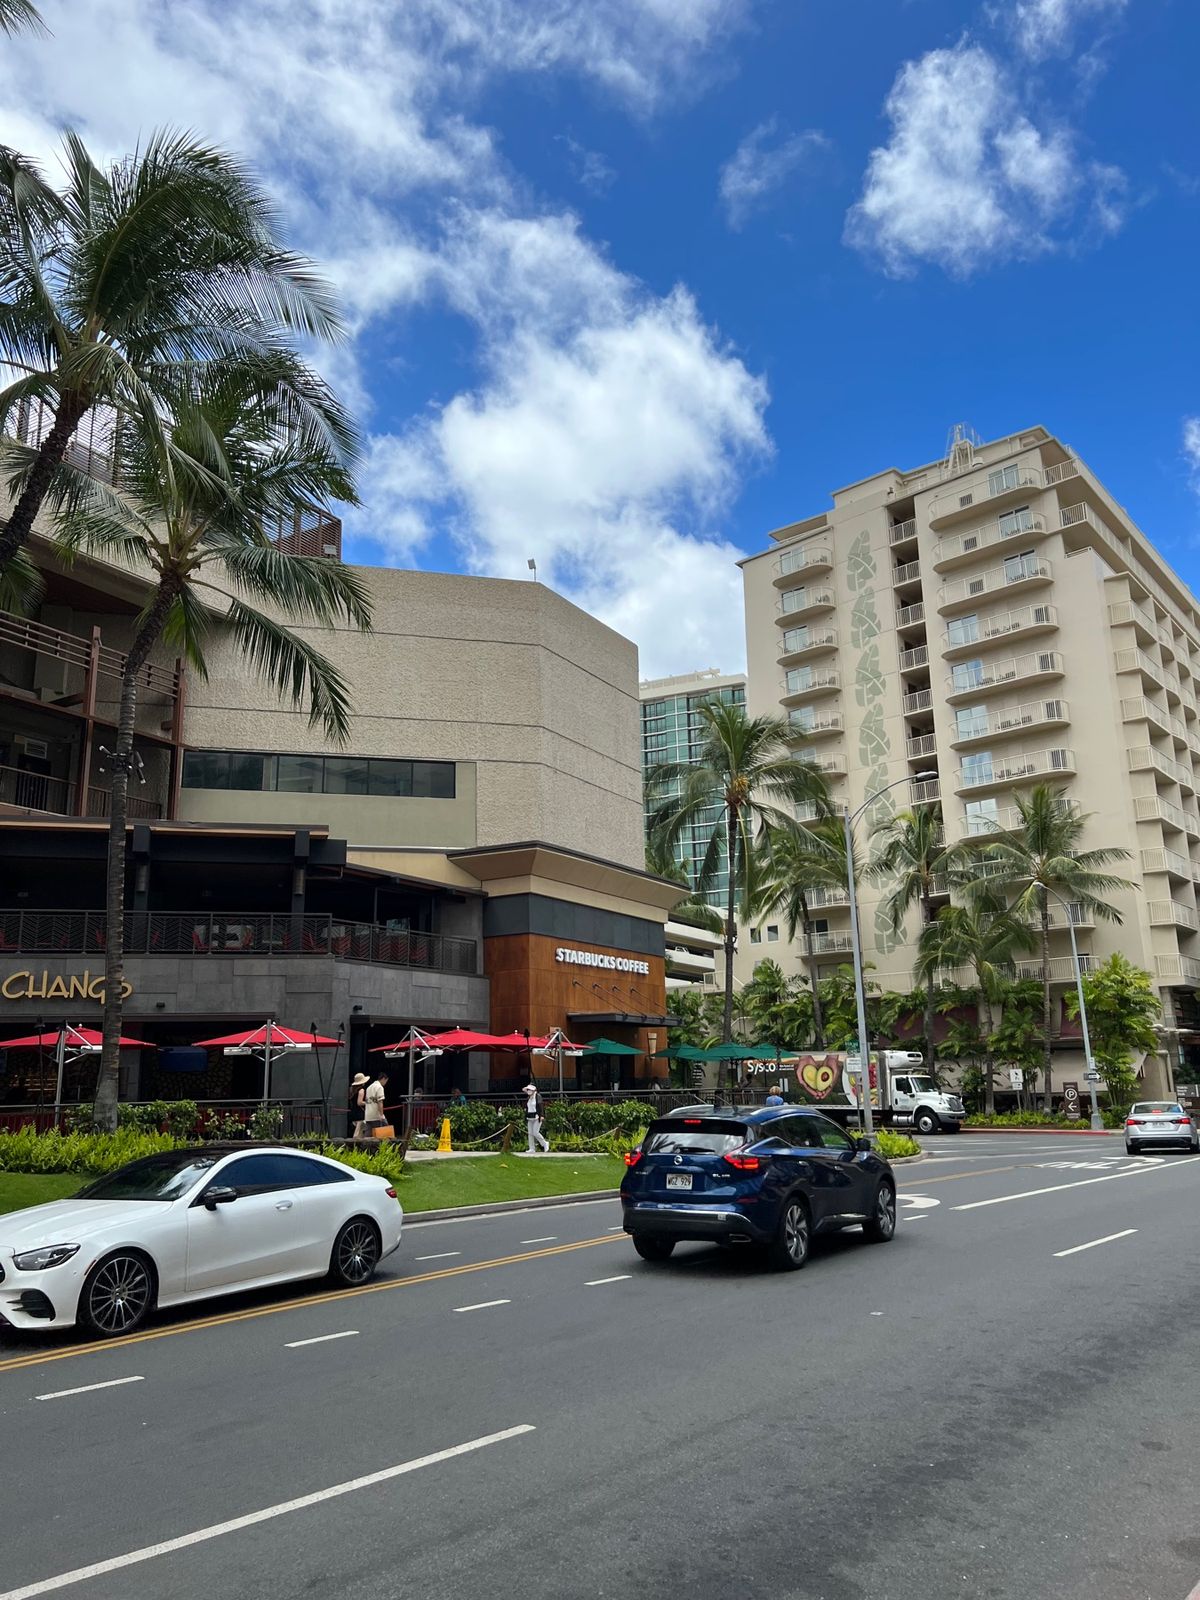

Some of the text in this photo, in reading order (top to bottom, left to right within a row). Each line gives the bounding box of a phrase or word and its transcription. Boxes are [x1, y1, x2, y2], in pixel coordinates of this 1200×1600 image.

[556, 947, 649, 974] STARBUCKS COFFEE
[1, 970, 132, 1004] CHANGS
[747, 1060, 776, 1075] Sysco
